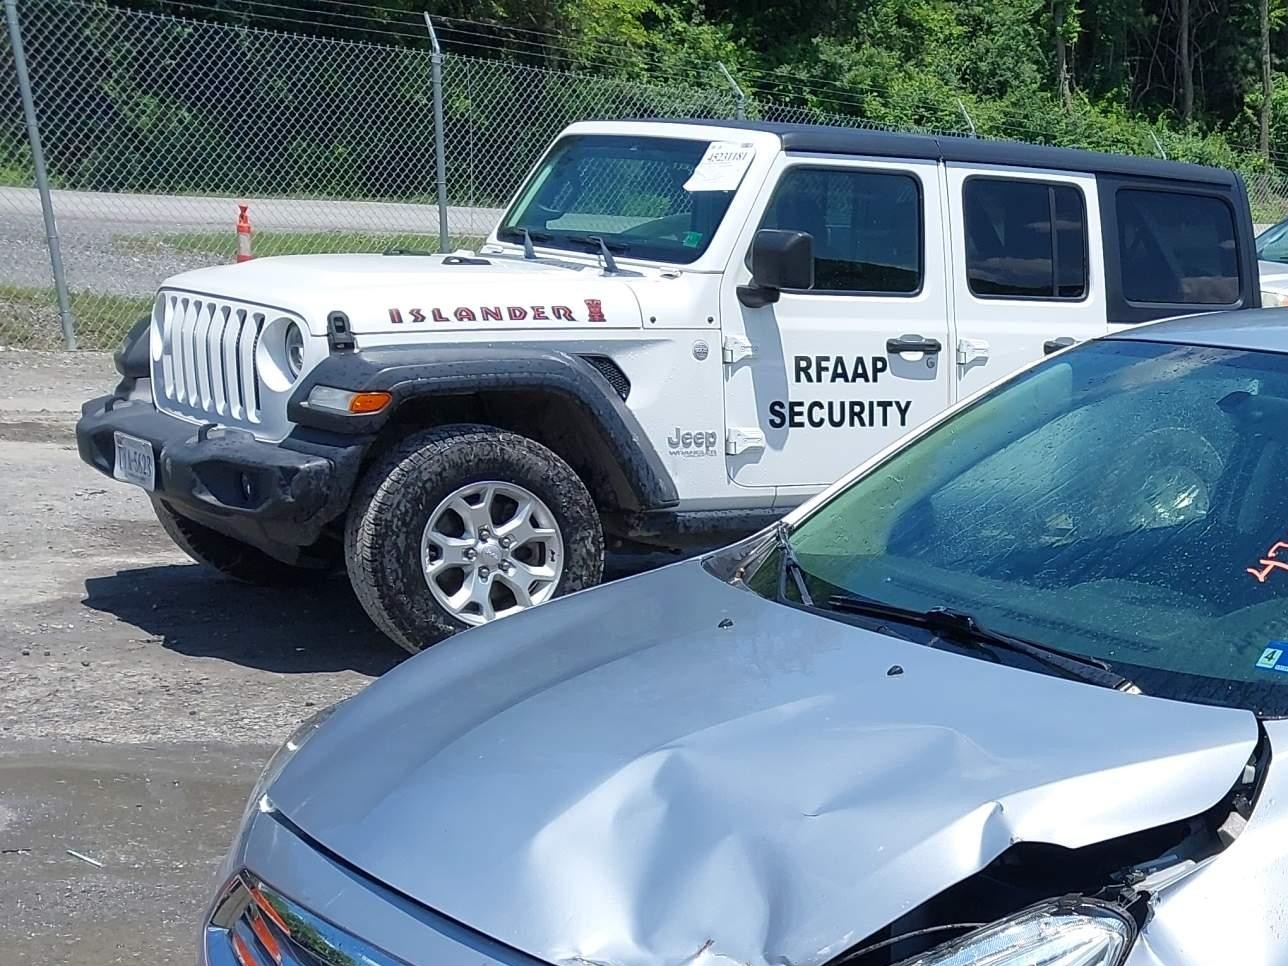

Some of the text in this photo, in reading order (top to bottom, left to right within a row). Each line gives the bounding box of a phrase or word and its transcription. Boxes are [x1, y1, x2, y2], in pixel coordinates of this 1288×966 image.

[388, 305, 577, 324] ISLANDER
[794, 355, 888, 383] RFAAP
[768, 400, 912, 428] SECURITY
[667, 426, 718, 453] Jeep
[1263, 649, 1278, 662] 4
